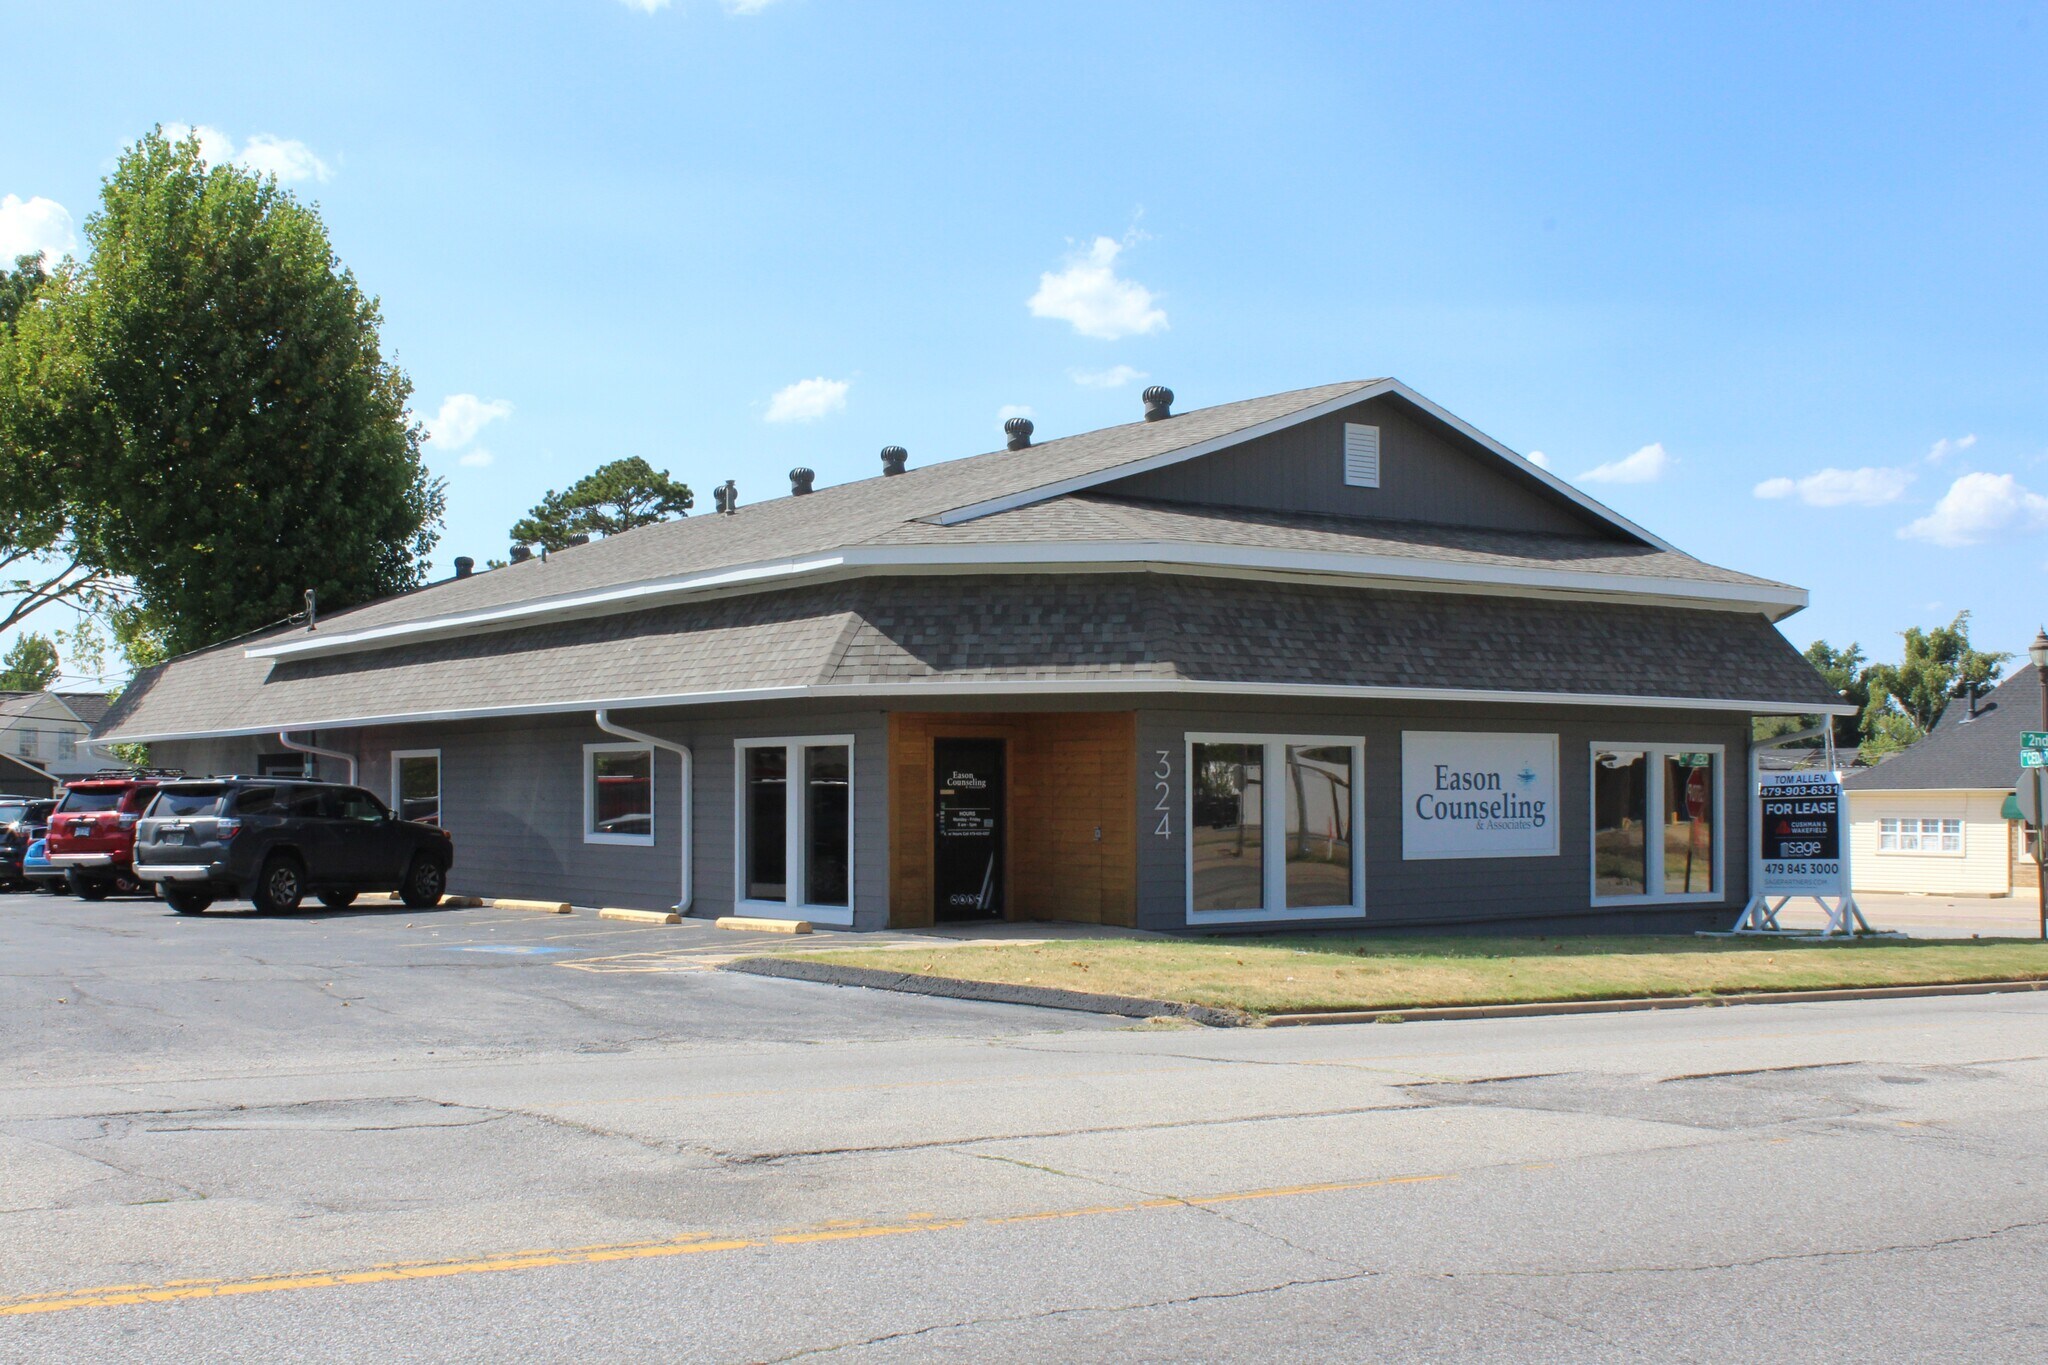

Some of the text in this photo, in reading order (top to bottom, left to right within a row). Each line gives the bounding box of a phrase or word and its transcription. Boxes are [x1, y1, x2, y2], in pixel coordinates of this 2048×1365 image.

[2028, 734, 2048, 746] 2nd
[953, 771, 974, 779] Eason
[1434, 764, 1502, 791] Eason
[1774, 774, 1826, 784] TOM ALLEN
[947, 778, 986, 788] Counseling
[1154, 750, 1171, 840] 324
[1761, 784, 1839, 797] 479-903-6331
[1416, 793, 1546, 828] Counseling
[1766, 802, 1836, 815] FOR LEASE
[1476, 819, 1531, 831] & Associates
[1788, 841, 1821, 857] sage
[1764, 863, 1838, 874] 479 845 3000
